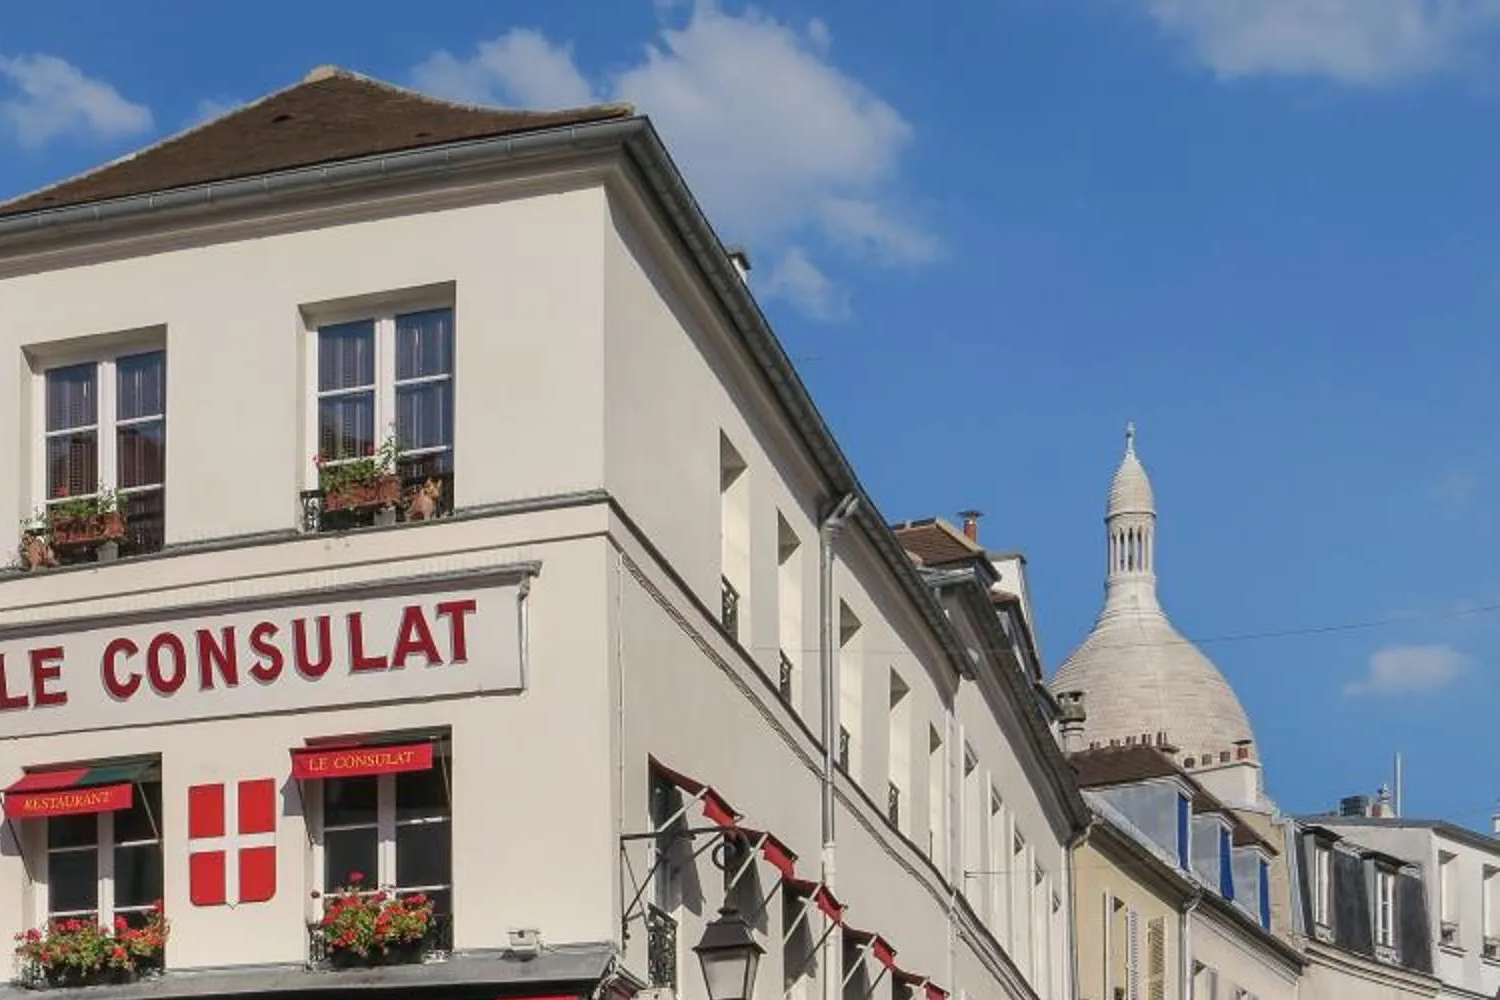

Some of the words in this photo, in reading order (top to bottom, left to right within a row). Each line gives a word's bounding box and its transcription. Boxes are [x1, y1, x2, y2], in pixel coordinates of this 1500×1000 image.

[102, 598, 477, 701] CONSULAT
[309, 757, 327, 772] LE
[333, 751, 414, 769] CONSULAT
[23, 790, 112, 812] RESTAURANT
